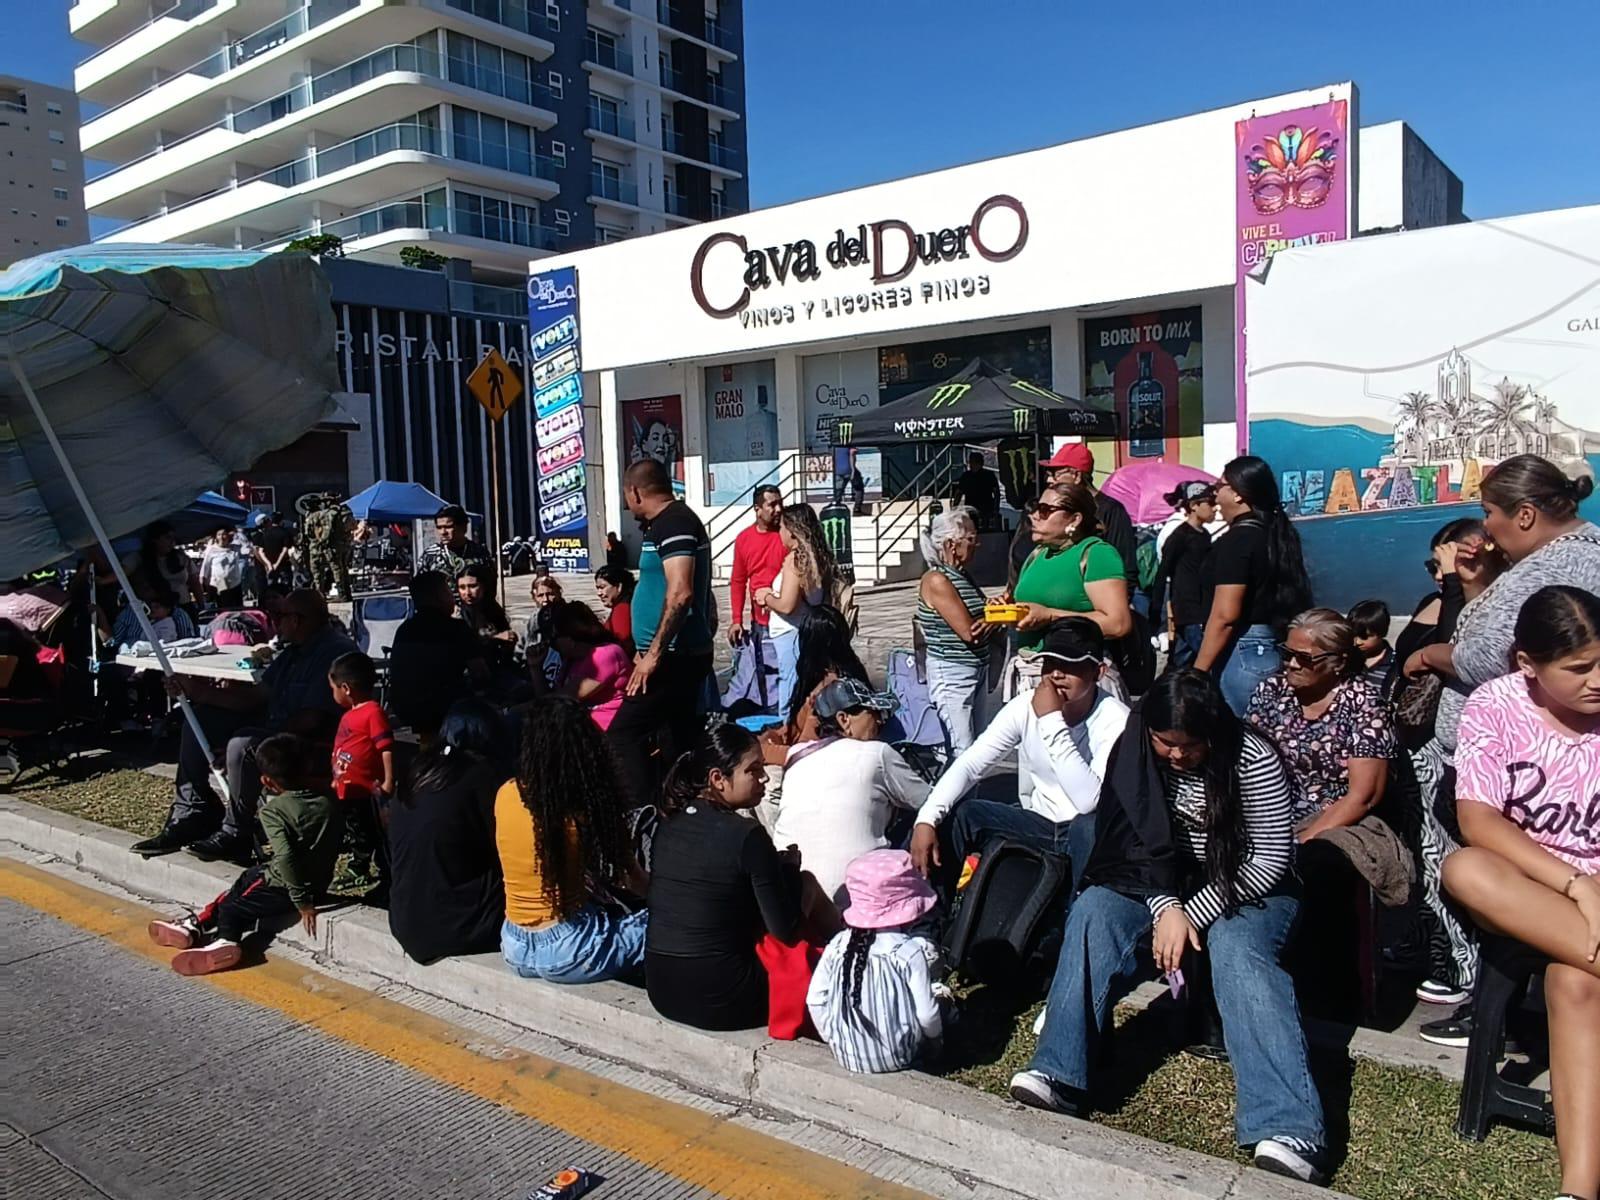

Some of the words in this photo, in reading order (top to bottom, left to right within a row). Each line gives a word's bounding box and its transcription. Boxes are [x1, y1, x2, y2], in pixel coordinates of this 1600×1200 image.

[1242, 225, 1266, 240] VIVE
[1269, 223, 1283, 236] EL
[691, 232, 821, 319] Cava
[826, 225, 870, 269] del
[738, 305, 795, 330] VINOS
[802, 300, 815, 321] Y
[920, 275, 991, 306] FINOS
[536, 322, 570, 350] VOLT
[1100, 327, 1140, 347] BORN
[1143, 324, 1163, 342] TO
[1165, 320, 1192, 340] MIX
[335, 330, 463, 363] RISTAL
[539, 380, 574, 406] VOLT
[715, 389, 743, 405] GRAN
[816, 384, 846, 404] Cava
[540, 409, 575, 436] VOLT
[715, 403, 744, 420] MALO
[894, 416, 965, 434] MONSTER
[541, 437, 578, 465] VOLT
[543, 468, 578, 492] VOLT
[544, 496, 578, 521] VOLT
[541, 548, 554, 558] LO
[555, 548, 588, 558] MEJOR
[547, 538, 581, 548] ACTIVA
[553, 558, 566, 568] DE
[567, 558, 577, 568] TI
